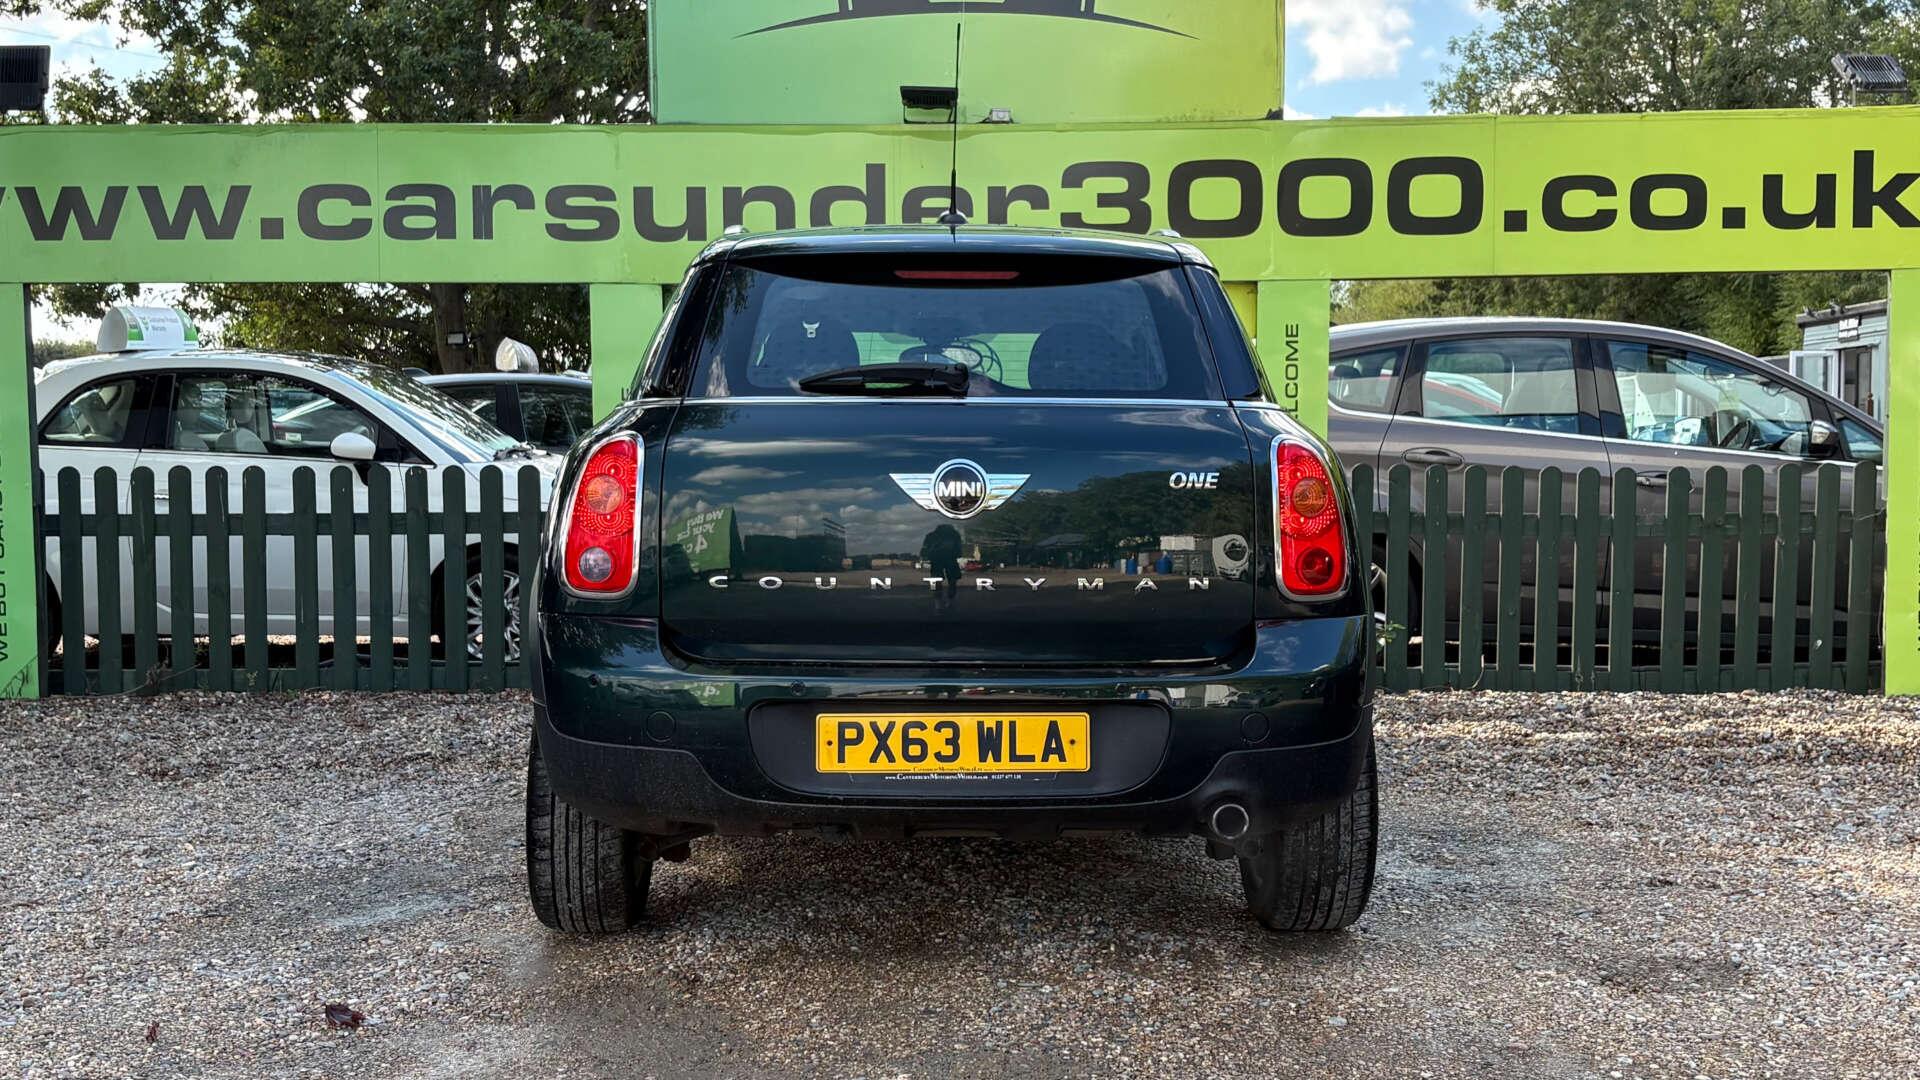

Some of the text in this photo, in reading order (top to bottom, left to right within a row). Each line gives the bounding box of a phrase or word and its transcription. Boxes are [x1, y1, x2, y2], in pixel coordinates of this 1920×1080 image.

[0, 149, 1920, 242] ww.carsunder3000.co.uk
[1284, 323, 1299, 419] LCOME
[938, 481, 982, 497] MINI
[1169, 472, 1220, 489] ONE
[708, 575, 1210, 591] COUNTRYMAN
[837, 720, 1067, 763] PX63 WLA
